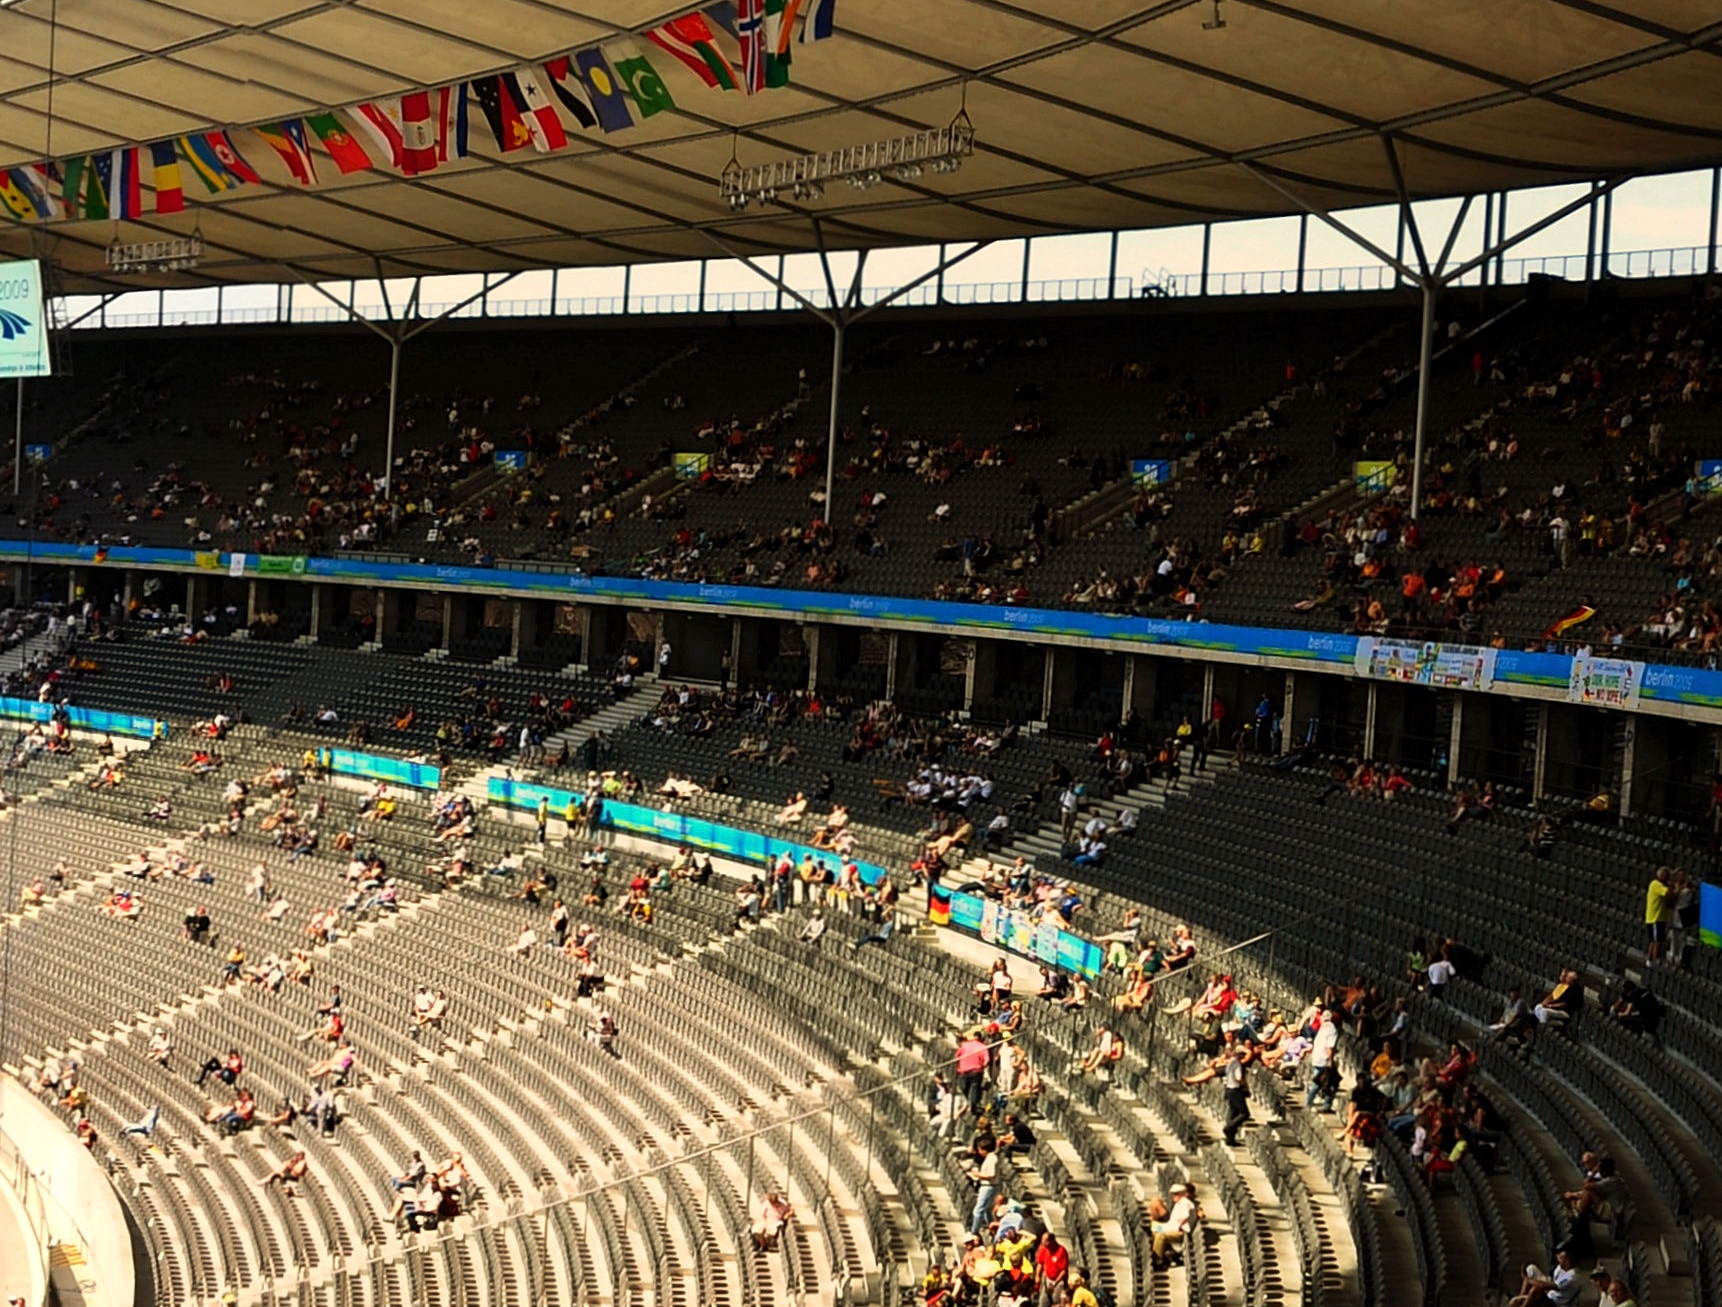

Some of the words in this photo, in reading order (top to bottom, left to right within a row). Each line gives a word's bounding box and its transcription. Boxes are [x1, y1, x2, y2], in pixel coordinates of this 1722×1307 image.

[699, 585, 722, 598] berlin
[849, 597, 873, 610] berlin
[1003, 609, 1028, 623] berlin
[1147, 621, 1171, 634] berlin
[1307, 636, 1333, 651] berlin
[1645, 668, 1674, 688] berlin
